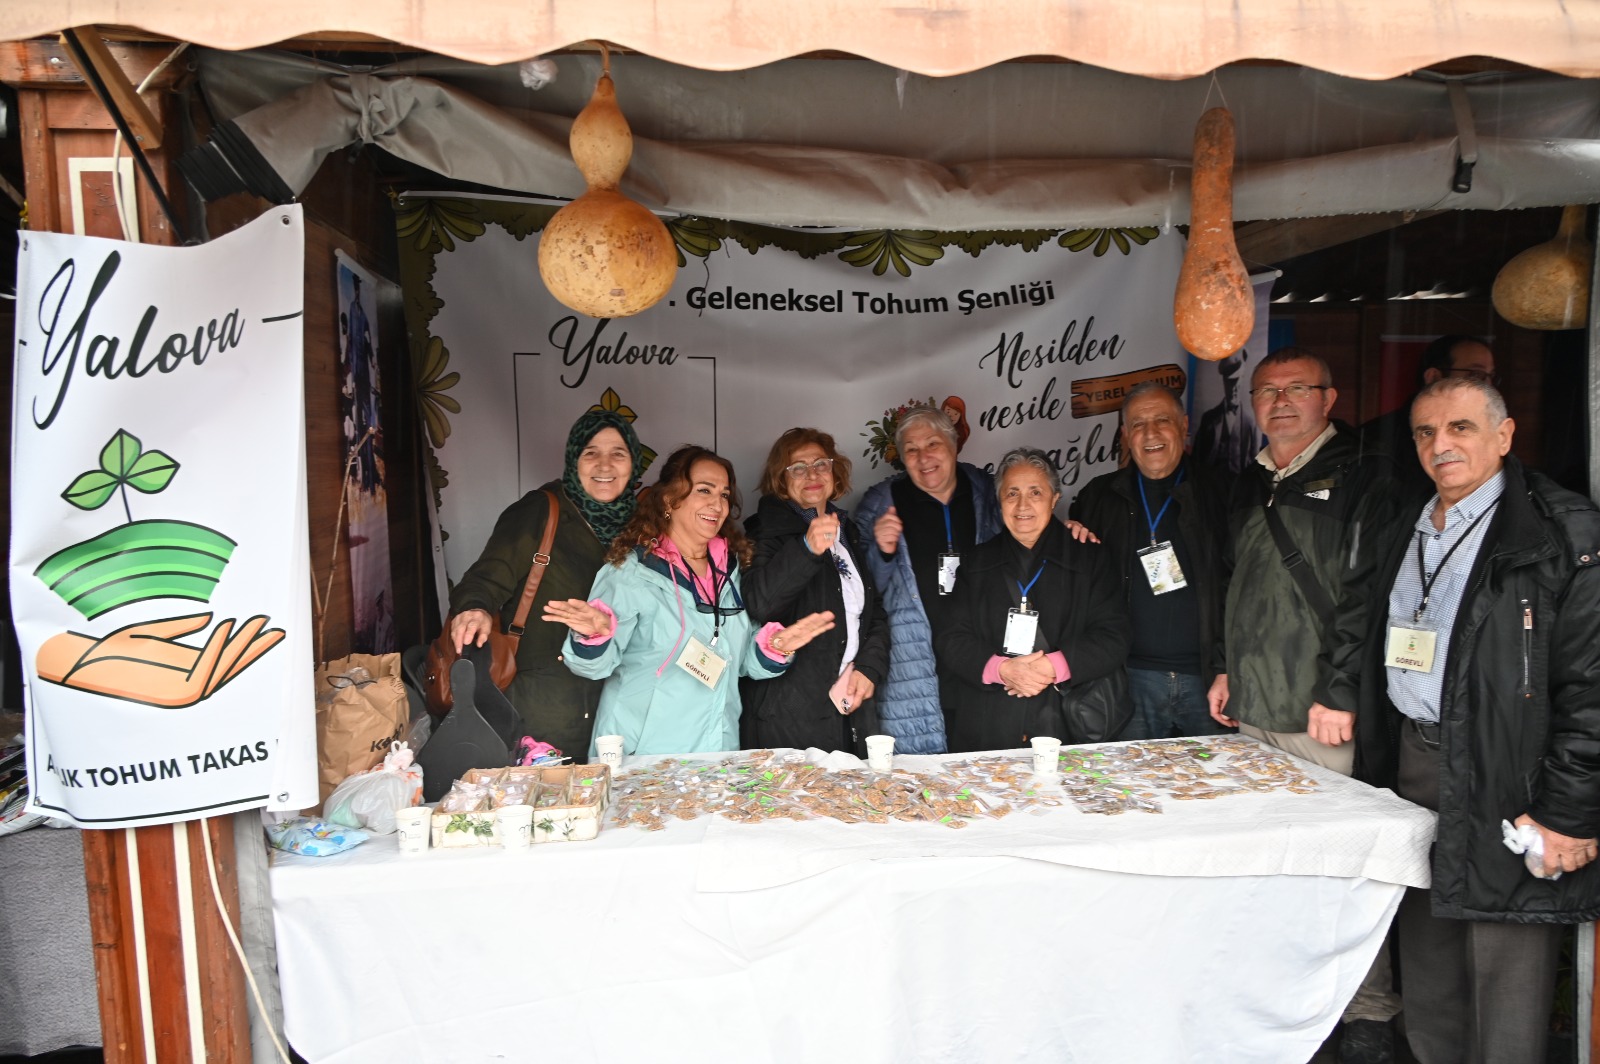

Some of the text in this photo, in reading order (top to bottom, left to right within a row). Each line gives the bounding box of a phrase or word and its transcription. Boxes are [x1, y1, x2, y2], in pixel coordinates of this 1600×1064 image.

[685, 281, 1055, 315] Geleneksel Tohum Şenliği
[33, 250, 246, 430] Yalova
[548, 315, 680, 389] Yalova
[978, 315, 1126, 389] Nesilden
[979, 376, 1067, 431] nesile
[1085, 386, 1126, 402] YEREL
[1046, 422, 1124, 487] ağlık
[685, 661, 710, 682] GÖREVLİ
[86, 758, 182, 788] TOHUM
[187, 741, 269, 774] TAKAS
